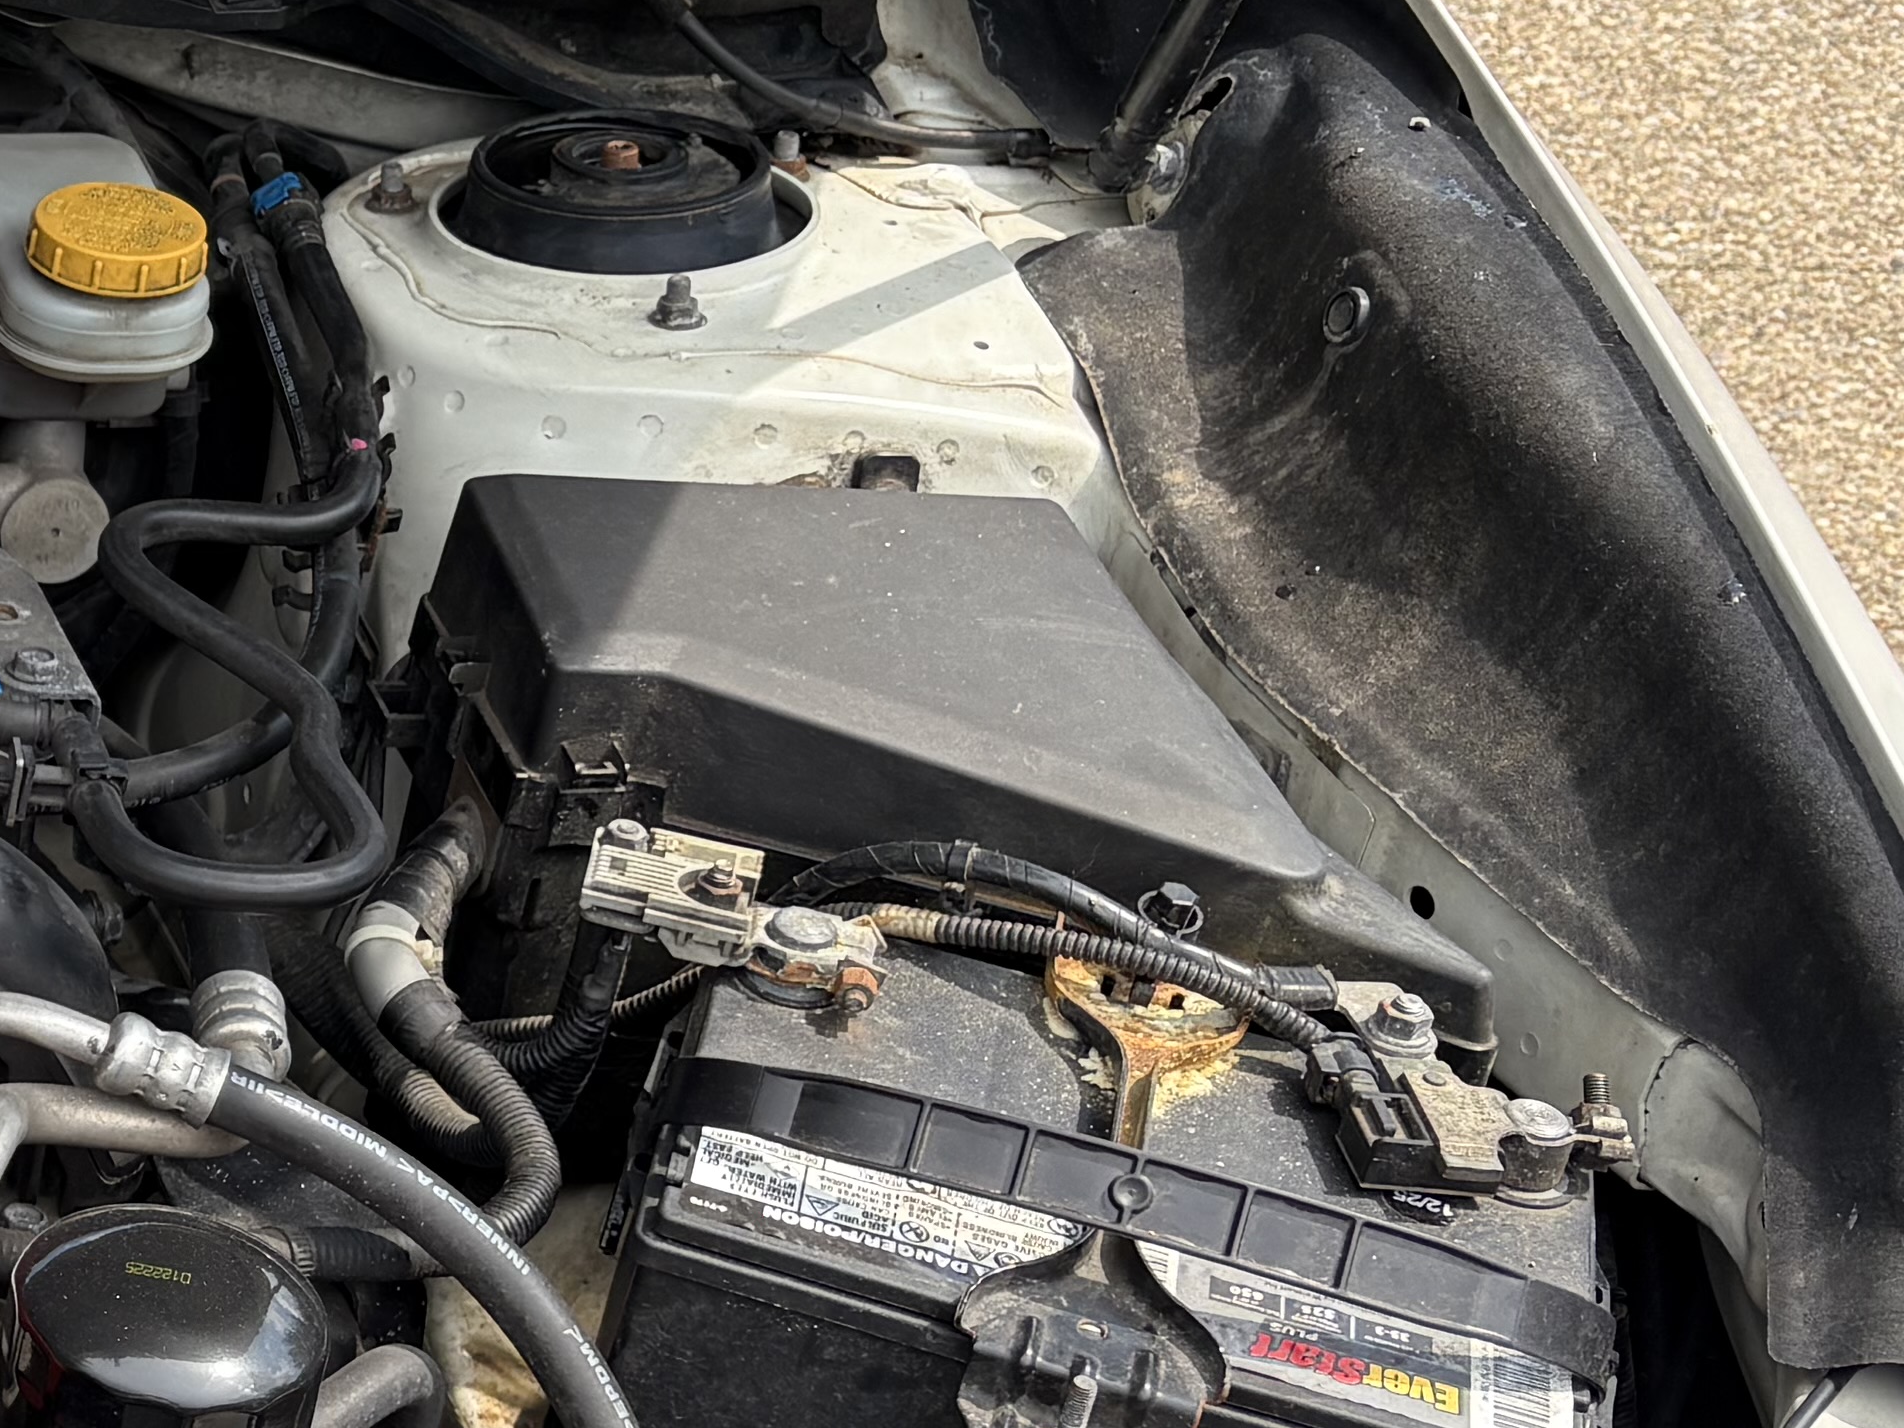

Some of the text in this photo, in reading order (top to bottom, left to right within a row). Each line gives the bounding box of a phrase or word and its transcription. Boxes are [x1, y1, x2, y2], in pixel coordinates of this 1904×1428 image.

[769, 1176, 798, 1191] WITH
[1392, 1189, 1455, 1218] 12/25
[861, 1210, 891, 1225] ACID
[762, 1205, 969, 1274] DANGER/POISON
[1229, 1284, 1265, 1301] 650
[1269, 1322, 1319, 1341] PLUS
[1249, 1332, 1460, 1416] EverStart
